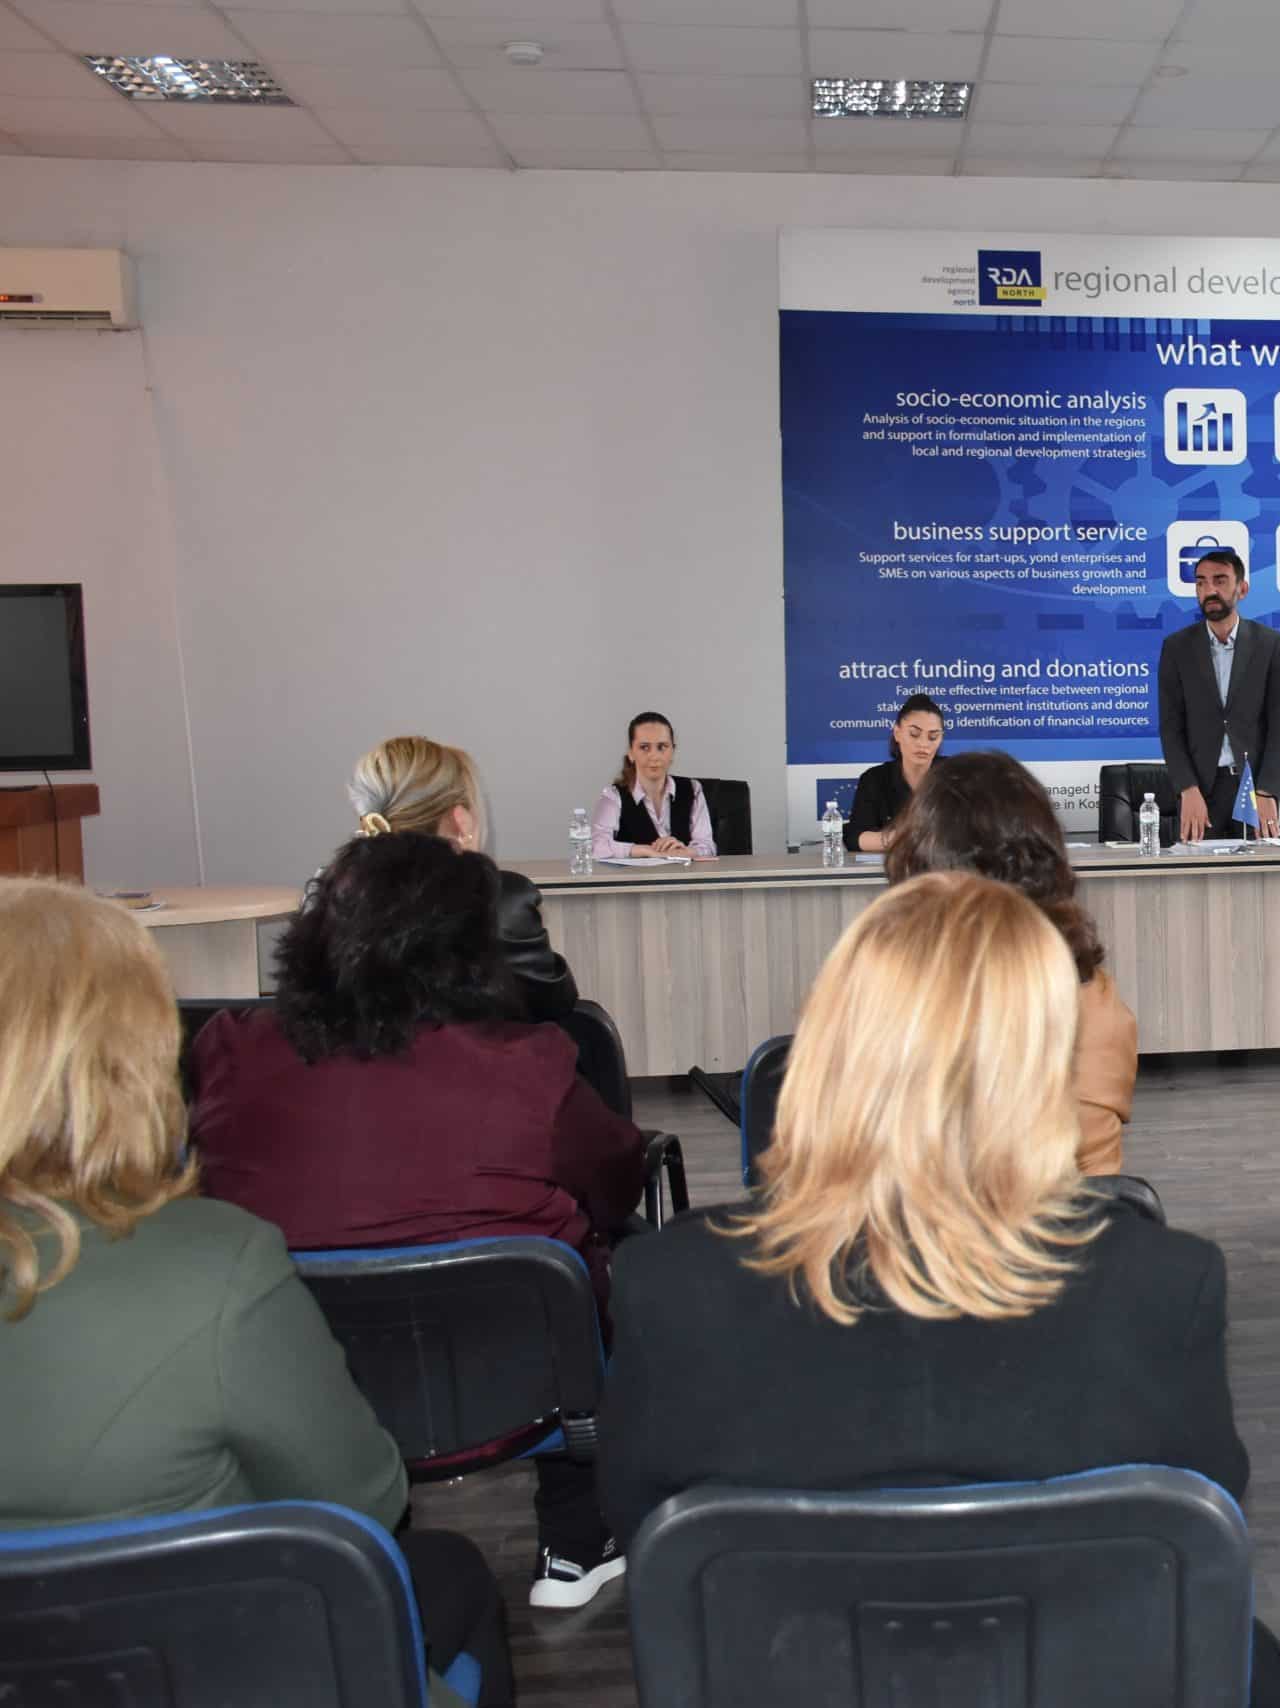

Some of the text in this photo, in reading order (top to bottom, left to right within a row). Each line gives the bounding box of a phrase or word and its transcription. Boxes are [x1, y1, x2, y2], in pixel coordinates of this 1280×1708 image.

[987, 268, 1032, 285] RDA
[1054, 266, 1177, 298] regional
[1157, 337, 1241, 366] what
[896, 389, 1146, 413] socio-economic analysis
[863, 413, 1145, 429] Analysis of socio-economic situation in the regions
[863, 428, 1145, 445] and support in formulation and implementation of
[912, 445, 1145, 460] local and regional development strategies
[894, 522, 1147, 544] business support service
[859, 552, 1146, 565] Support services for start-ups, yond enterprises and
[879, 568, 1146, 581] SMEs on various aspects of business growth and
[1072, 584, 1146, 596] development
[839, 660, 1149, 682] attract funding and donations
[896, 684, 1148, 697] Facilitate effective interface between regional
[954, 701, 1023, 713] government
[1026, 700, 1088, 711] institutions
[1091, 700, 1112, 710] and
[1115, 699, 1148, 710] donor
[957, 716, 1031, 728] identification
[1034, 716, 1045, 727] of
[1048, 715, 1095, 726] financial
[1097, 716, 1148, 726] resources
